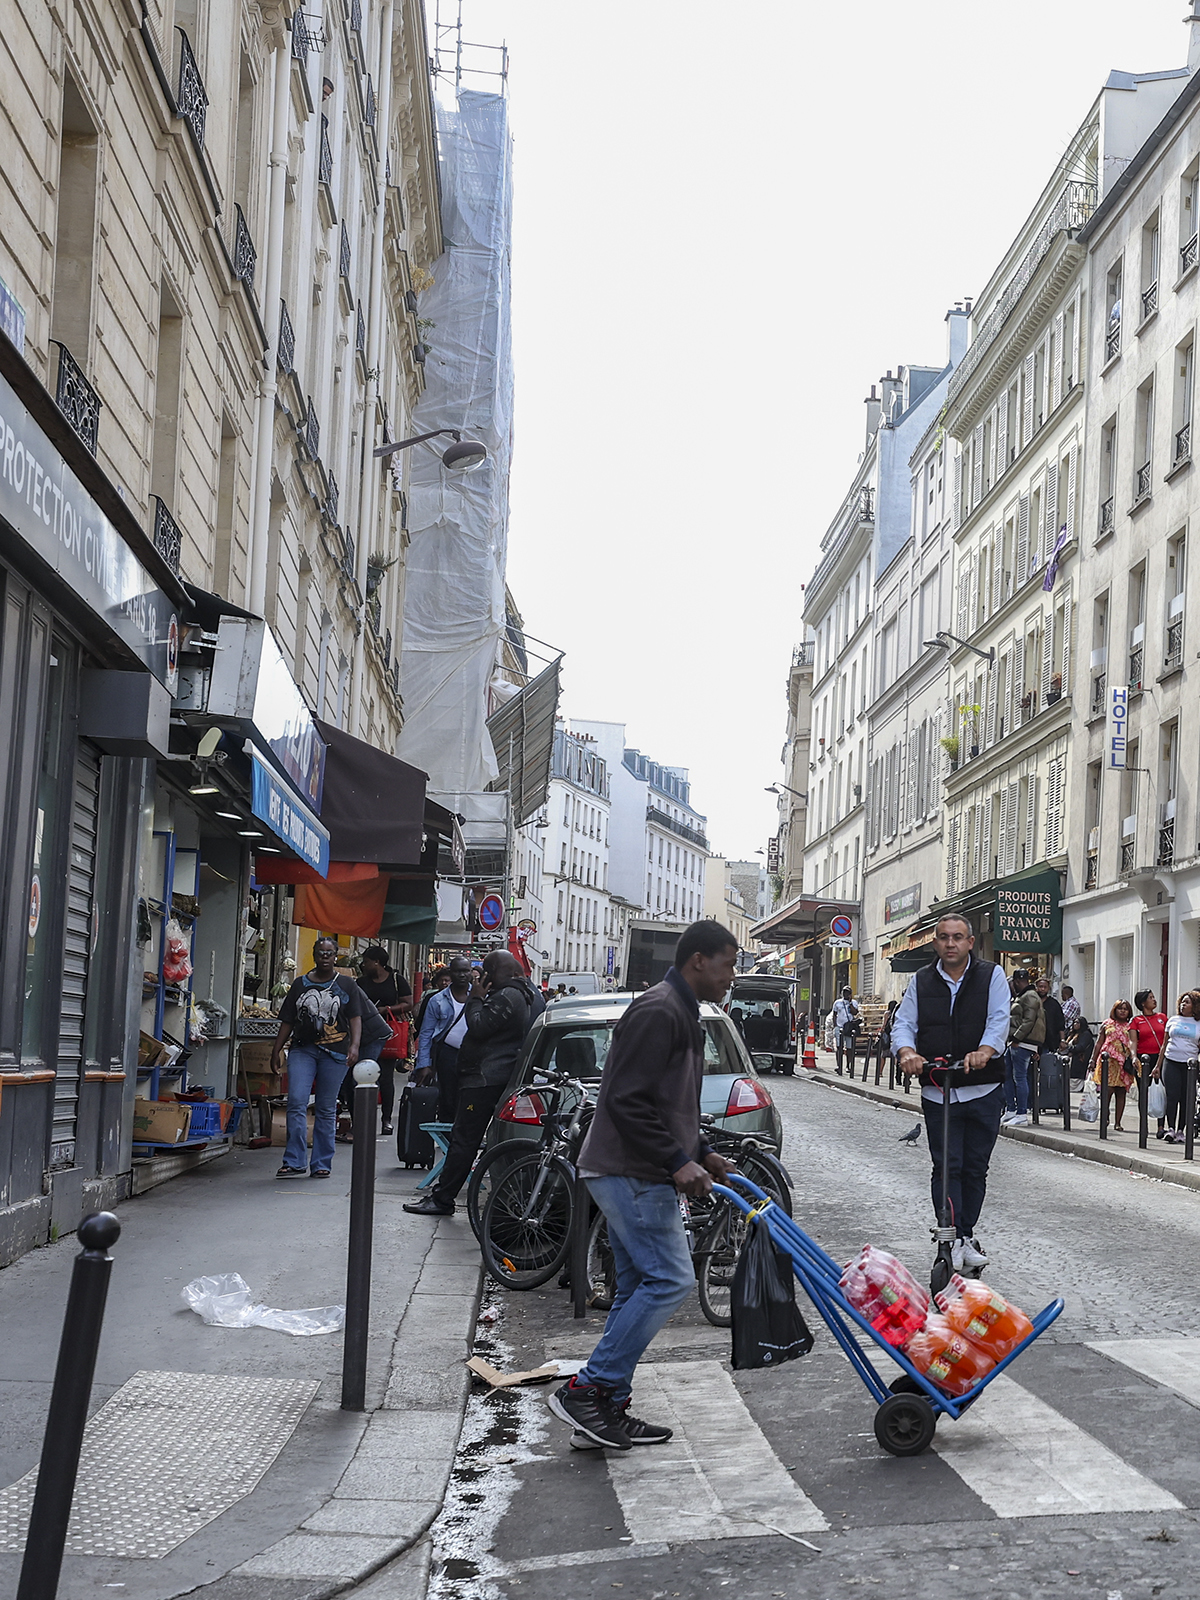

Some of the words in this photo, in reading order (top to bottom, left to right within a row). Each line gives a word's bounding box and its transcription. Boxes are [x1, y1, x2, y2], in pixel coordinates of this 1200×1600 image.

[84, 527, 118, 601] CIVILE
[148, 603, 157, 645] 18
[1111, 689, 1126, 767] HOTEL
[768, 838, 779, 873] HOTEL
[998, 891, 1051, 903] PRODUITS
[998, 903, 1051, 915] EXOTIQUE
[999, 916, 1050, 929] FRANCE
[1002, 929, 1041, 942] RAMA
